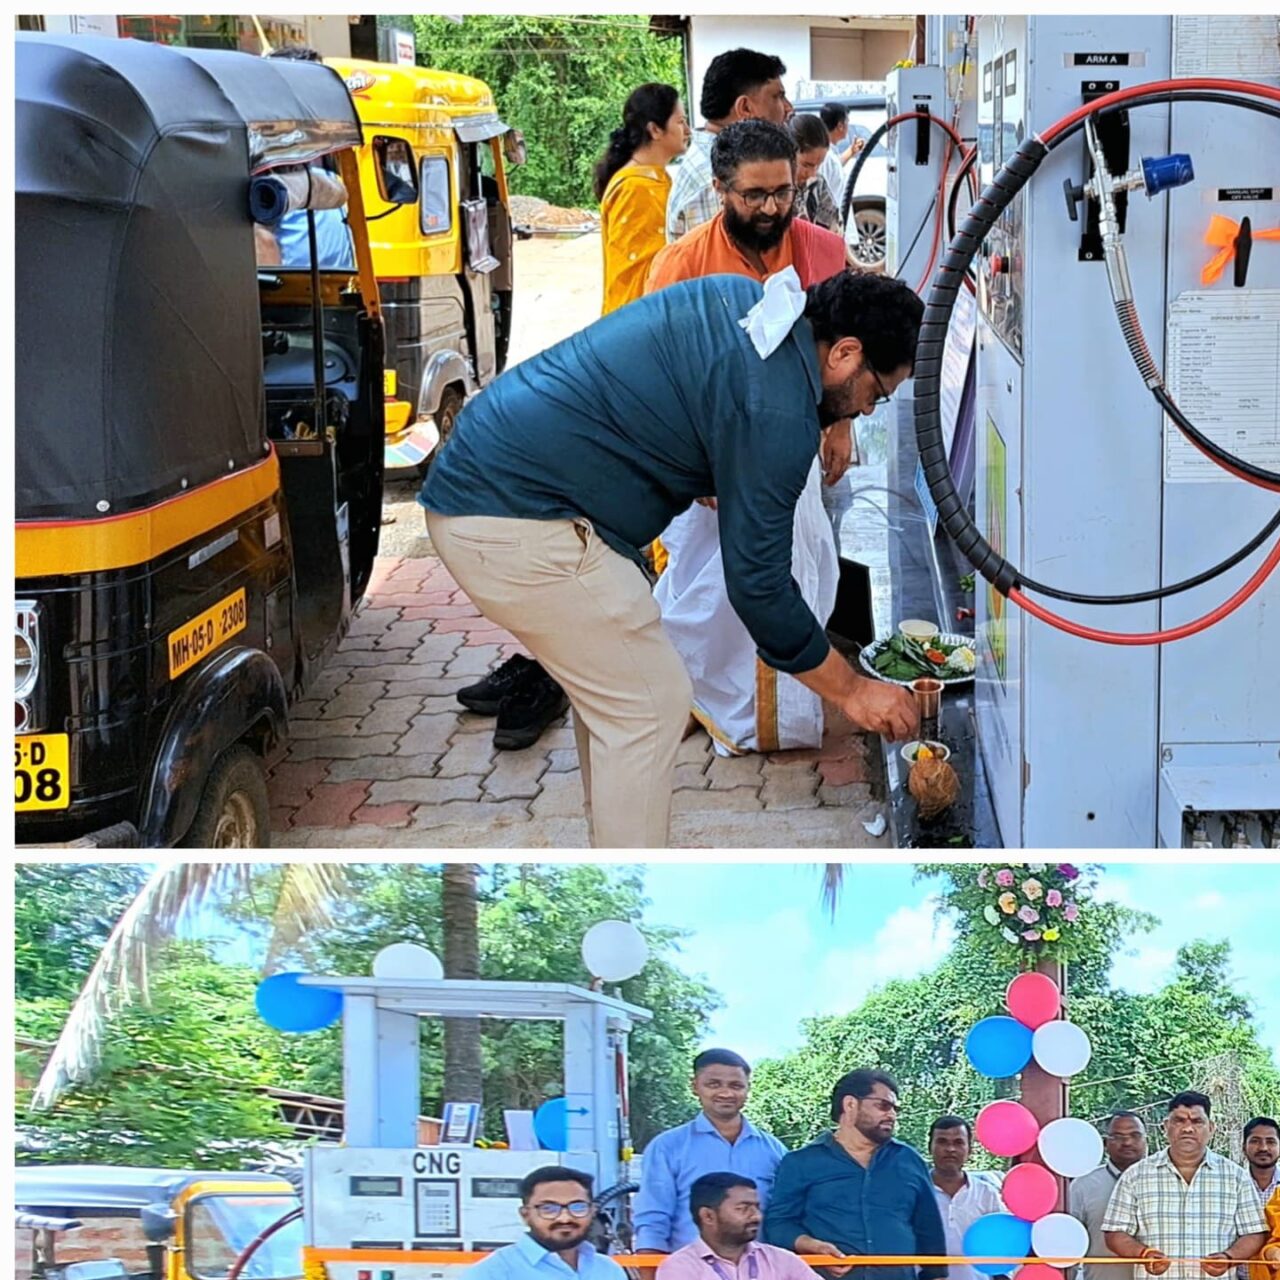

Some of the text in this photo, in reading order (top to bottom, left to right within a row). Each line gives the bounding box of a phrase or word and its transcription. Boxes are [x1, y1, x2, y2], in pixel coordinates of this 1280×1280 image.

[1086, 55, 1118, 64] ARM A
[172, 625, 214, 672] MH-05-D
[15, 768, 62, 804] 08
[413, 1151, 462, 1174] CNG
